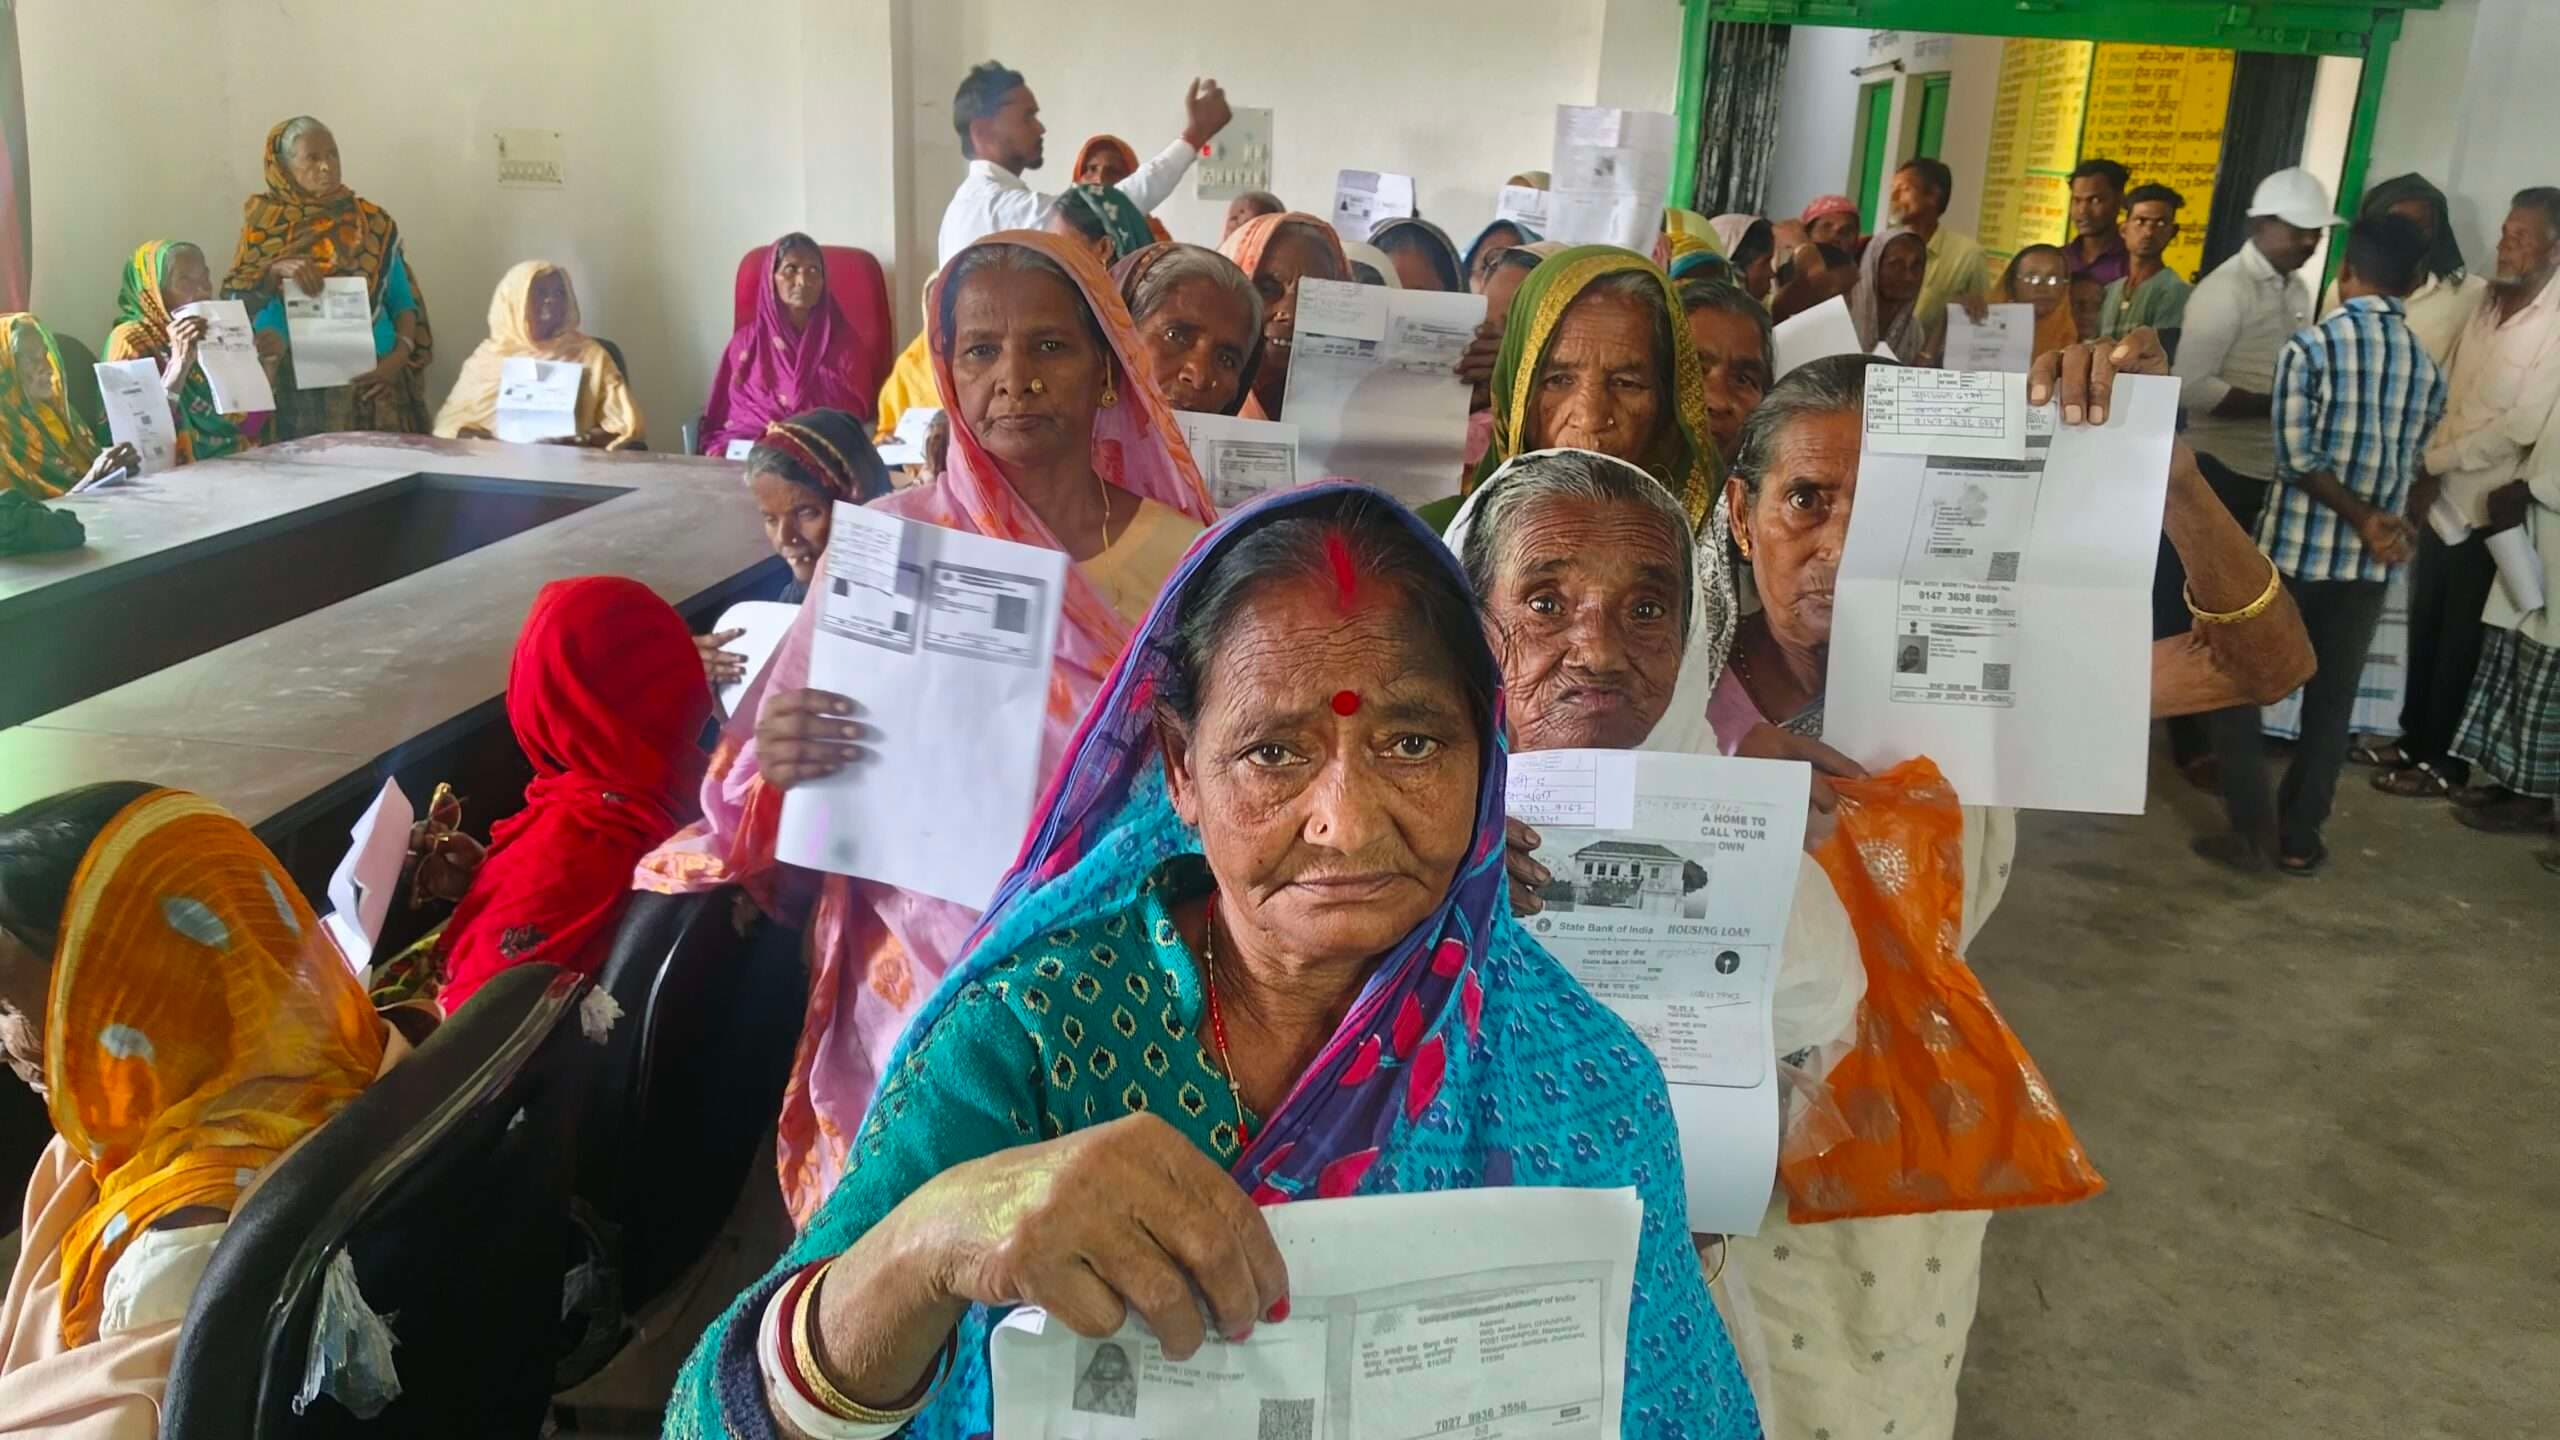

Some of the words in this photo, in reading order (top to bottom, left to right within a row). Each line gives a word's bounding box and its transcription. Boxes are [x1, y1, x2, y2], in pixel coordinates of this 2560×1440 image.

[1702, 813, 1711, 822] A
[1713, 814, 1748, 826] HOME
[1751, 816, 1767, 827] TO
[1701, 826, 1730, 838] CALL
[1734, 829, 1766, 840] YOUR
[1718, 841, 1745, 852] OWN
[1559, 921, 1585, 932] State
[1587, 923, 1613, 933] Bank
[1616, 924, 1628, 934] of
[1629, 925, 1654, 935] India
[1667, 924, 1718, 937] HOUSING
[1720, 926, 1751, 938] LOAN
[1544, 1295, 1554, 1304] of
[1555, 1294, 1577, 1304] India
